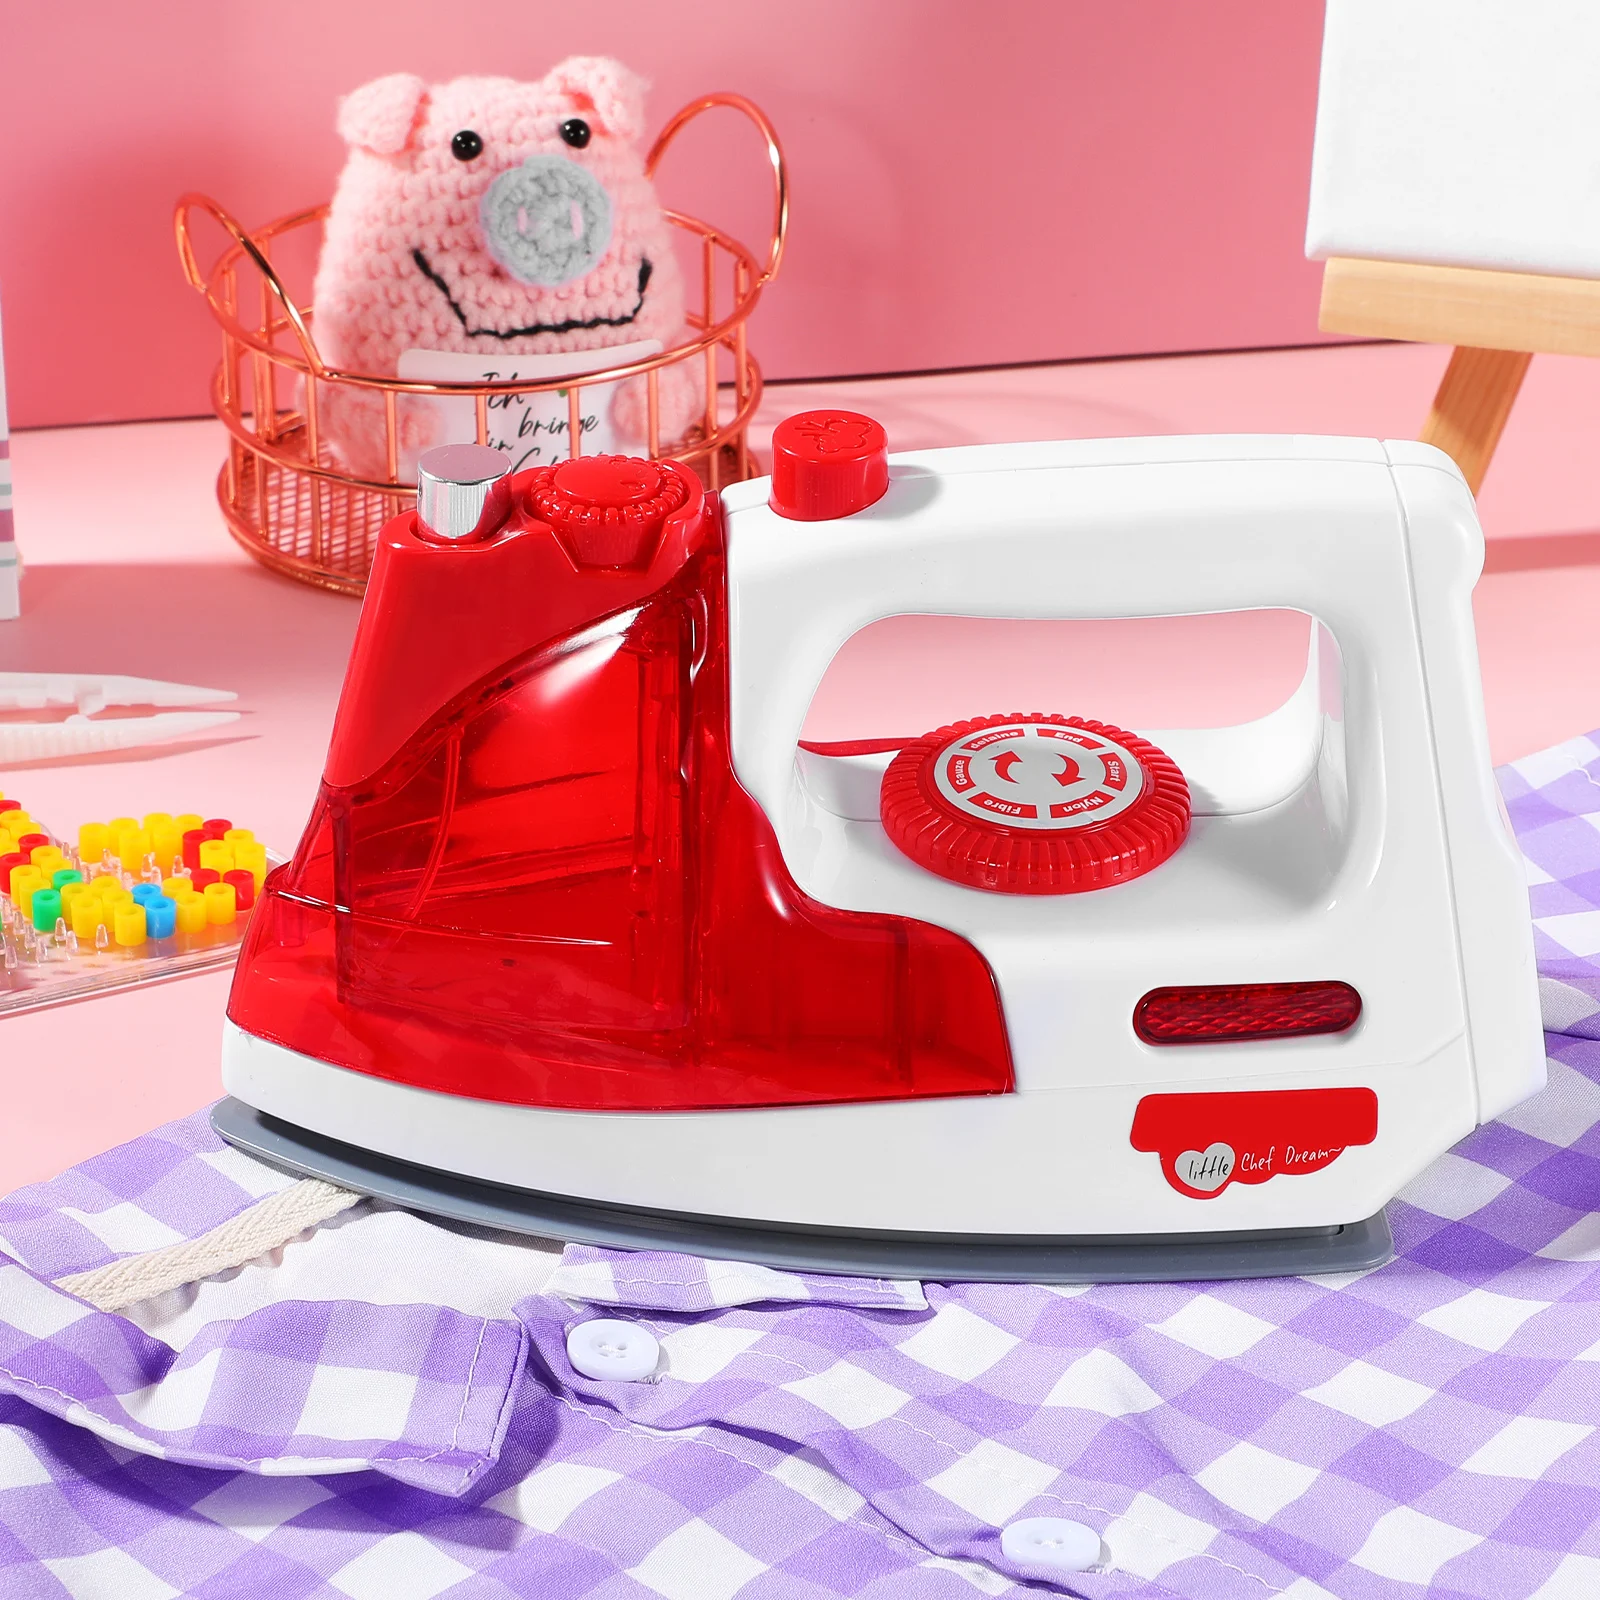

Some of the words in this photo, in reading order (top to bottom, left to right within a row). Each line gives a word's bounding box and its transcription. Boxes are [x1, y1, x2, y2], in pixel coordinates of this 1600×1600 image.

[970, 731, 1019, 749] delaine
[1054, 731, 1084, 743] End
[954, 759, 968, 786] Gauze
[1107, 760, 1121, 783] Start
[983, 799, 1022, 815] Fibre
[1062, 796, 1104, 812] Nylon
[1188, 1155, 1229, 1180] little
[1241, 1145, 1276, 1172] Chef
